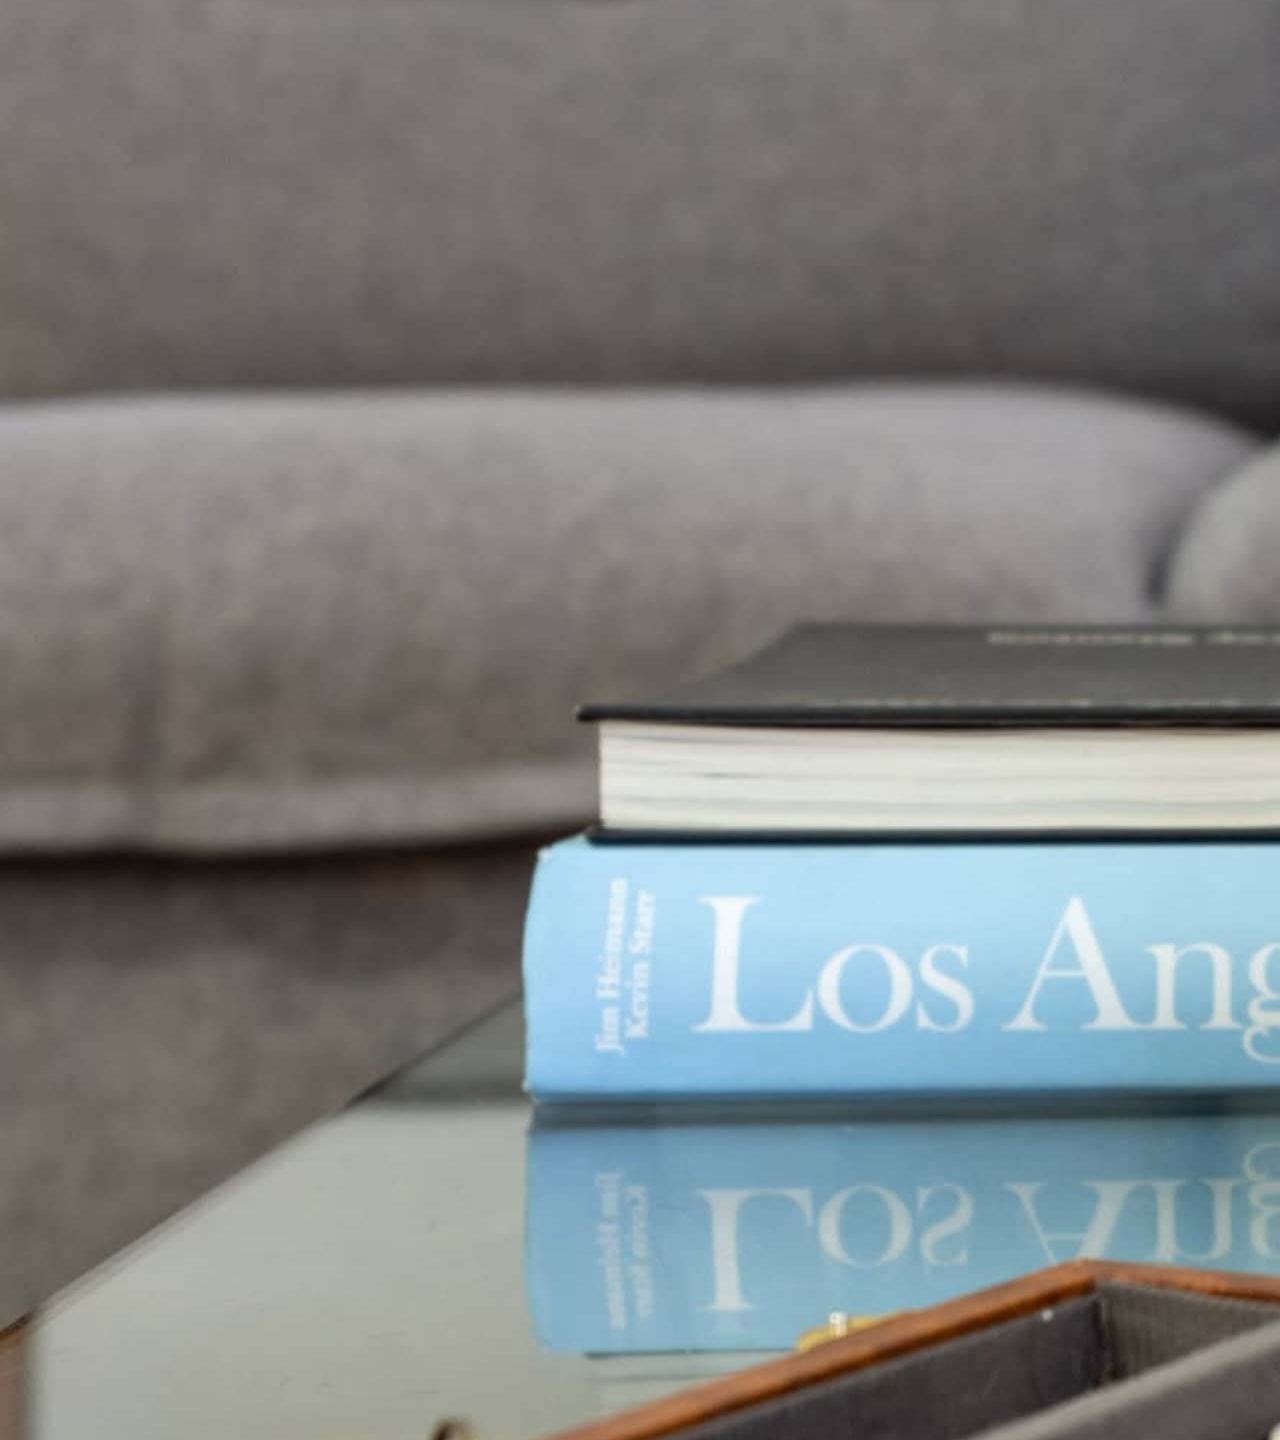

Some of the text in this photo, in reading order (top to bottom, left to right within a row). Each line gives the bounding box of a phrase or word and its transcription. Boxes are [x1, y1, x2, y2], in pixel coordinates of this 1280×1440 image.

[624, 962, 650, 1039] Kevin
[692, 894, 976, 1034] Los
[594, 1006, 626, 1056] Jim
